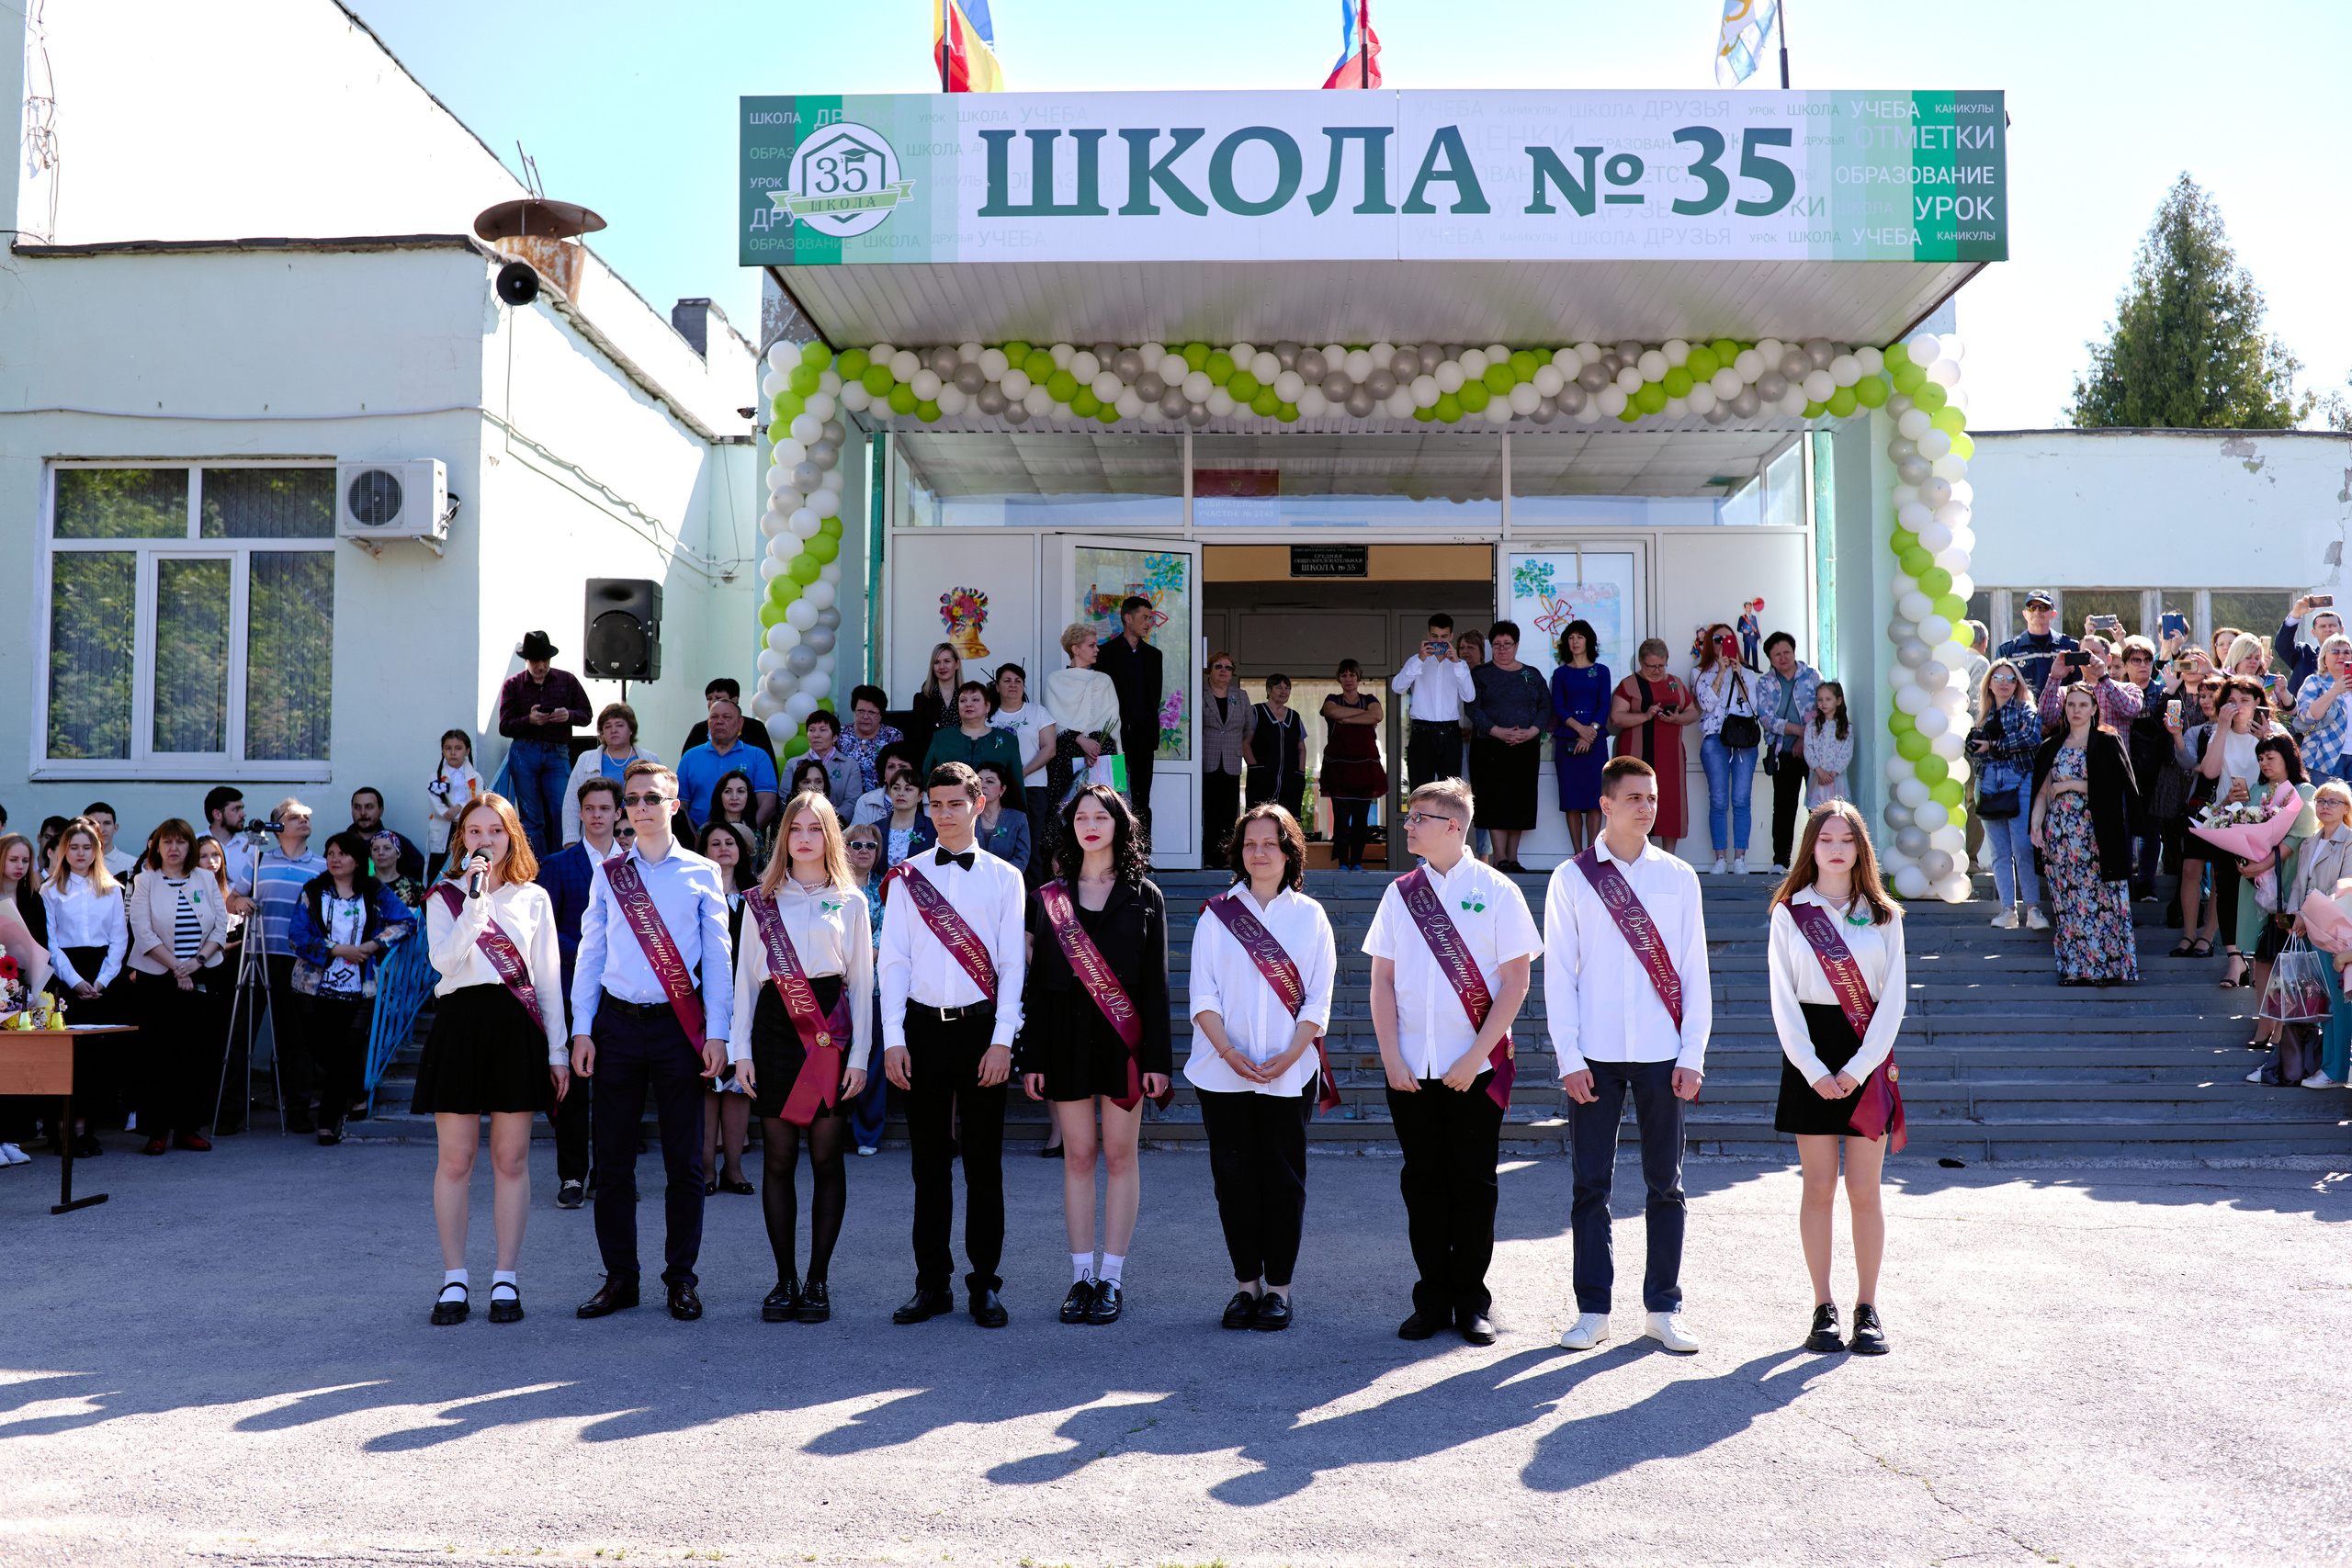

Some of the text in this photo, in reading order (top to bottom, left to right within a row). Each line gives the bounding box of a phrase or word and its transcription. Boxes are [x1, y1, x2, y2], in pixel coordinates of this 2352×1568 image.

[956, 110, 1009, 123] ШКОЛА
[1021, 107, 1089, 123] УЧЕБА
[1414, 100, 1484, 118] УЧЕБА
[1569, 103, 1635, 118] ШКОЛА
[1642, 100, 1730, 121] ДРУЗЬЯ
[1748, 106, 1776, 117] УРОК
[1787, 104, 1840, 117] ШКОЛА
[1850, 100, 1920, 118] УЧЕБА
[1935, 104, 1995, 114] КАНИКУЛЫ
[750, 112, 802, 125] ШКОЛА
[919, 113, 945, 123] УРОК
[1803, 136, 1845, 146] ДРУЗЬЯ
[1855, 125, 1996, 150] ОТМЕТКИ
[907, 143, 963, 156] ШКОЛА
[815, 157, 868, 193] 35
[978, 124, 1796, 218] ШКОЛА № 35
[1835, 166, 1995, 185] ОБРАЗОВАНИЕ
[750, 176, 783, 188] УРОК
[810, 196, 876, 212] ШКОЛА
[1915, 196, 1996, 220] УРОК
[749, 237, 853, 251] ОБРАЗОВАНИЕ
[864, 235, 921, 248] ШКОЛА
[932, 233, 973, 243] ДРУЗЬЯ
[978, 230, 1046, 248] УЧЕБА
[1570, 230, 1636, 245] ШКОЛА
[1644, 228, 1731, 248] ДРУЗЬЯ
[1749, 233, 1778, 243] УРОК
[1788, 231, 1841, 243] ШКОЛА
[1852, 228, 1922, 246] УЧЕБА
[1937, 231, 1996, 241] КАНИКУЛЫ
[1197, 500, 1274, 508] ИЗБИРАТЕЛЬНЫЙ
[627, 892, 673, 966] Выпускник
[662, 962, 693, 997] 2022
[930, 906, 989, 973] Выпускник
[1625, 907, 1671, 983] Выпускник
[1426, 915, 1476, 990] Выпускник
[1060, 922, 1108, 991] Выпускница
[1099, 986, 1134, 1022] 2022
[1825, 944, 1871, 1021] Выпускница
[783, 977, 814, 1014] 2022
